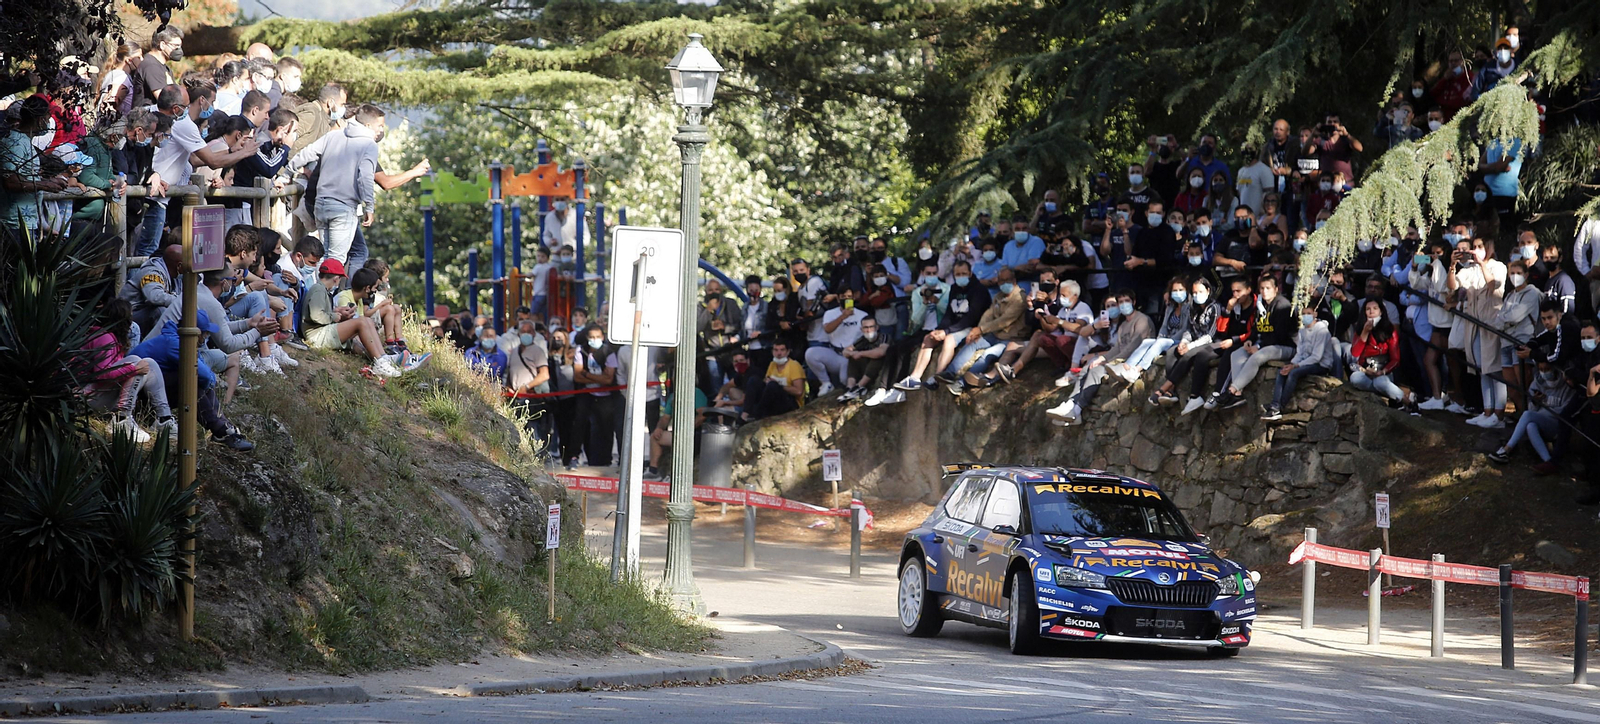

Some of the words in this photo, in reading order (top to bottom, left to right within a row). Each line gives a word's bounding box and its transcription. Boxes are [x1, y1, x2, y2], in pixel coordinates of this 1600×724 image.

[641, 246, 655, 257] 20
[1058, 484, 1139, 496] Recalvi
[954, 544, 966, 559] UFI
[1108, 549, 1186, 559] MOTUL
[1110, 558, 1197, 570] Recalvi
[946, 560, 1004, 608] Recalvi
[1038, 587, 1056, 595] RACC
[1039, 596, 1074, 608] MICHELIN
[1065, 617, 1101, 629] ŠKODA
[1060, 628, 1085, 636] MOTUL
